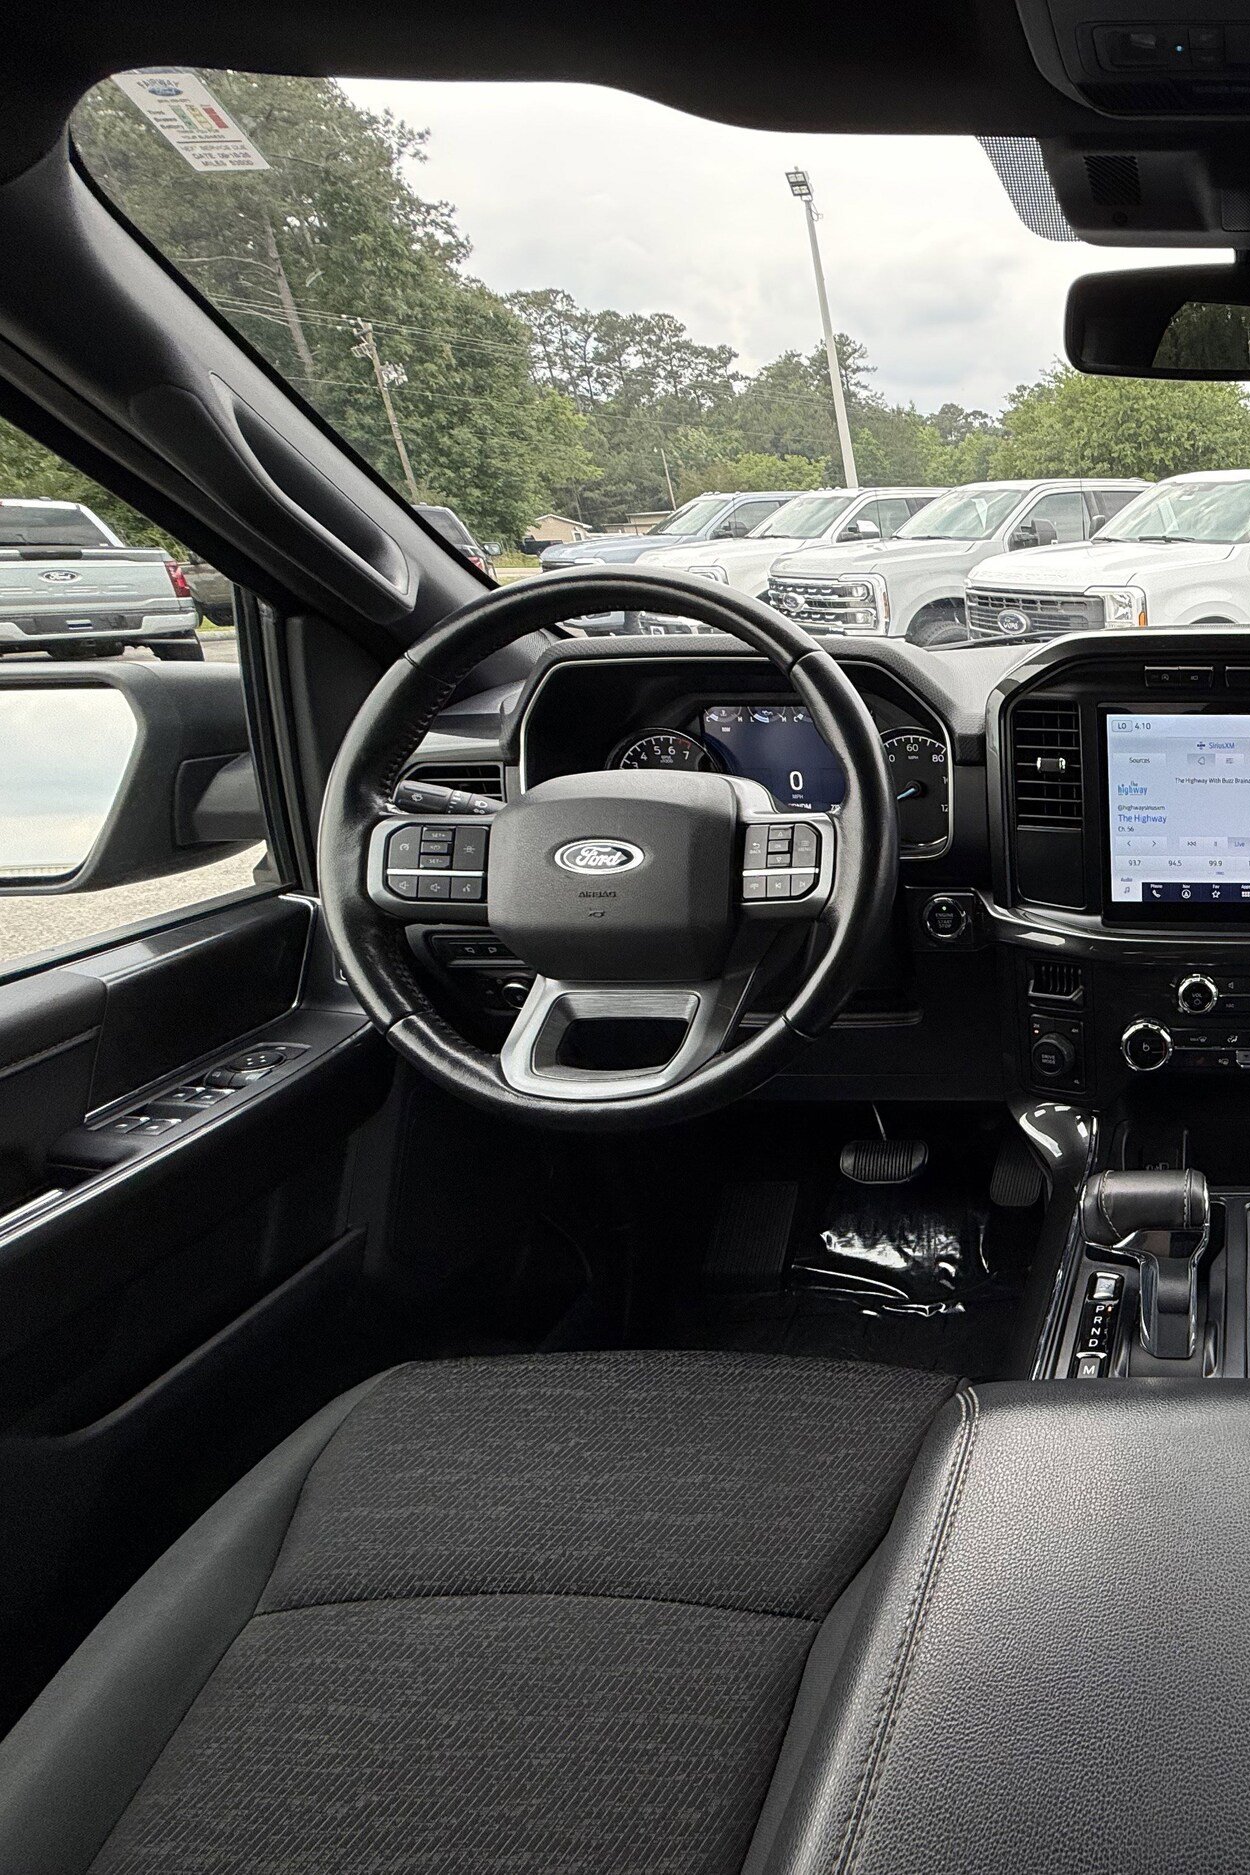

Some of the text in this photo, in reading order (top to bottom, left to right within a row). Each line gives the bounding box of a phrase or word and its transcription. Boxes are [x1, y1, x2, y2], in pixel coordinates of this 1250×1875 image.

[654, 746, 661, 755] 5
[668, 746, 676, 755] 6
[906, 744, 918, 752] 60
[640, 752, 648, 760] 4
[683, 751, 690, 760] 7
[932, 754, 944, 763] 80
[790, 770, 803, 790] 0
[1118, 814, 1167, 824] The Highway
[575, 844, 625, 867] Ford
[1094, 1316, 1102, 1324] R
[1091, 1328, 1100, 1336] N
[1088, 1339, 1098, 1347] D
[1082, 1365, 1096, 1375] M
